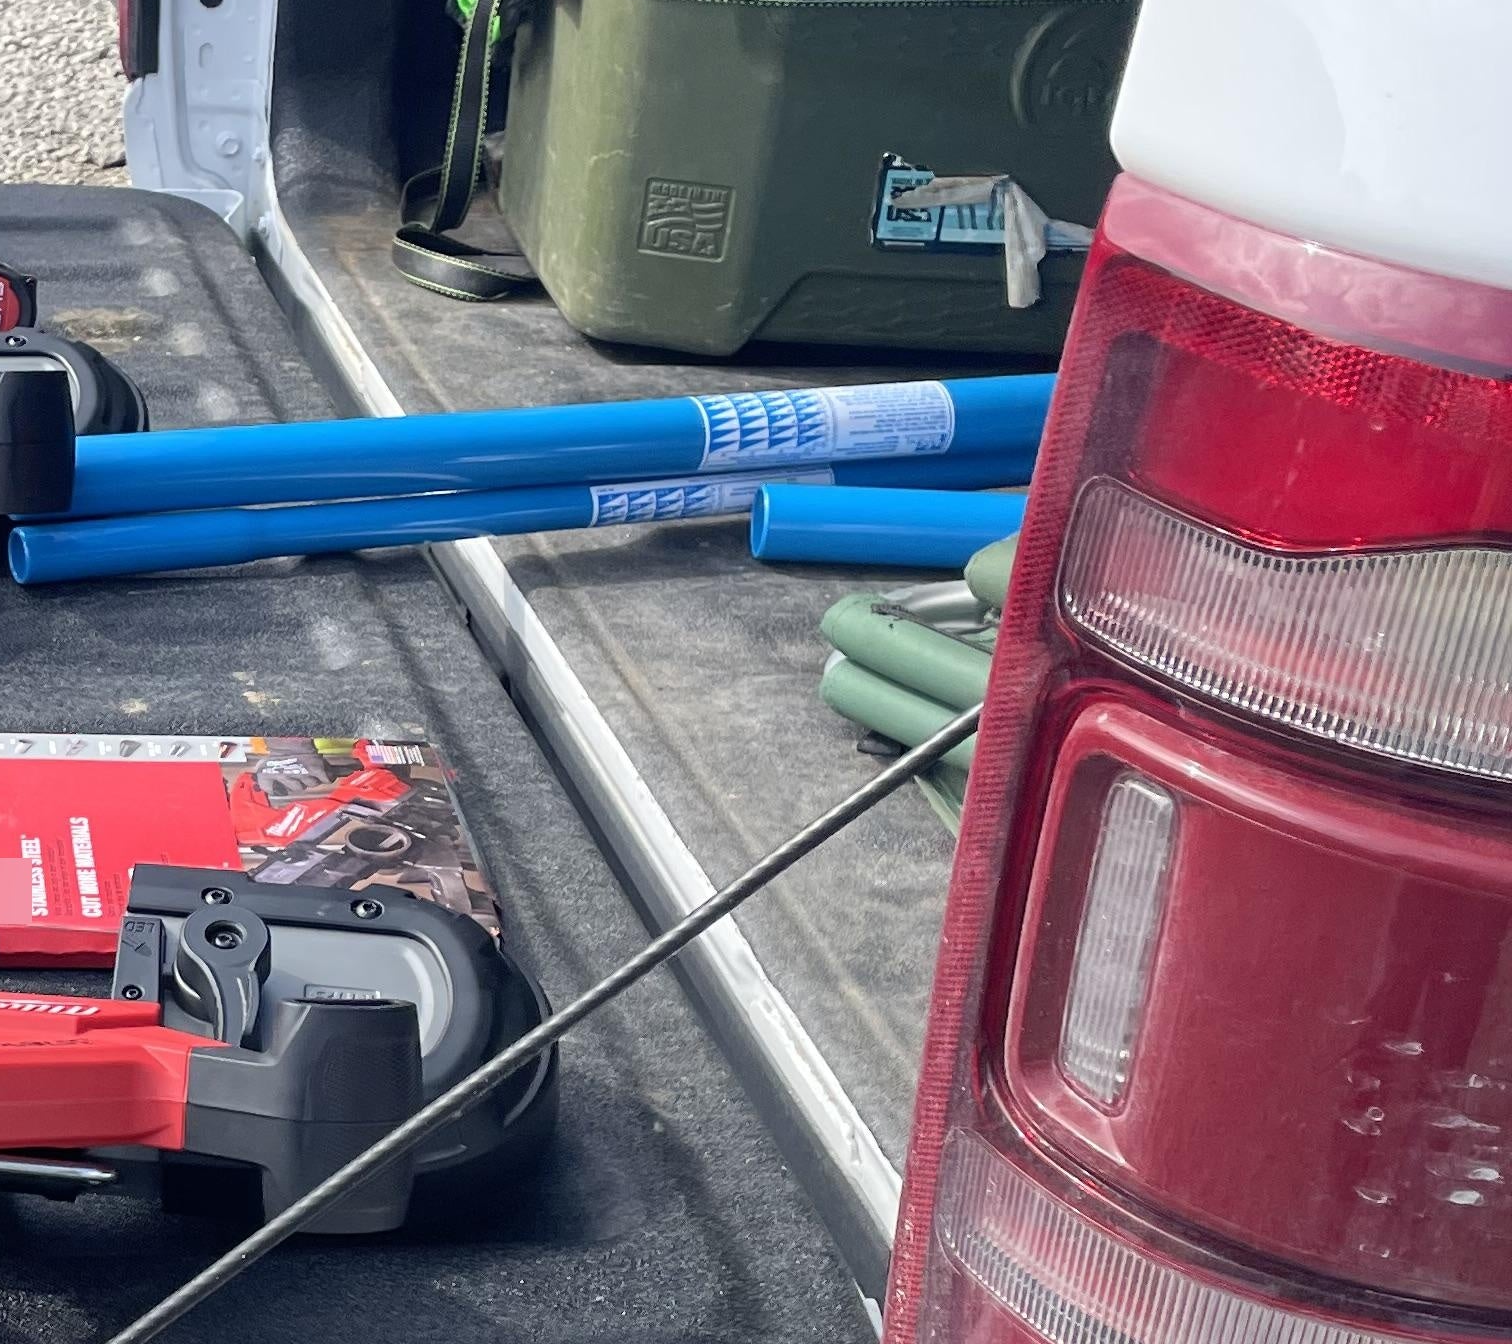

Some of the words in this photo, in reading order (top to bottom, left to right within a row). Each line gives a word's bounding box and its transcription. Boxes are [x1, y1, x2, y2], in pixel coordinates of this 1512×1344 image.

[70, 816, 96, 868] MATERIALS
[77, 868, 100, 895] MORE
[81, 896, 103, 918] CUT
